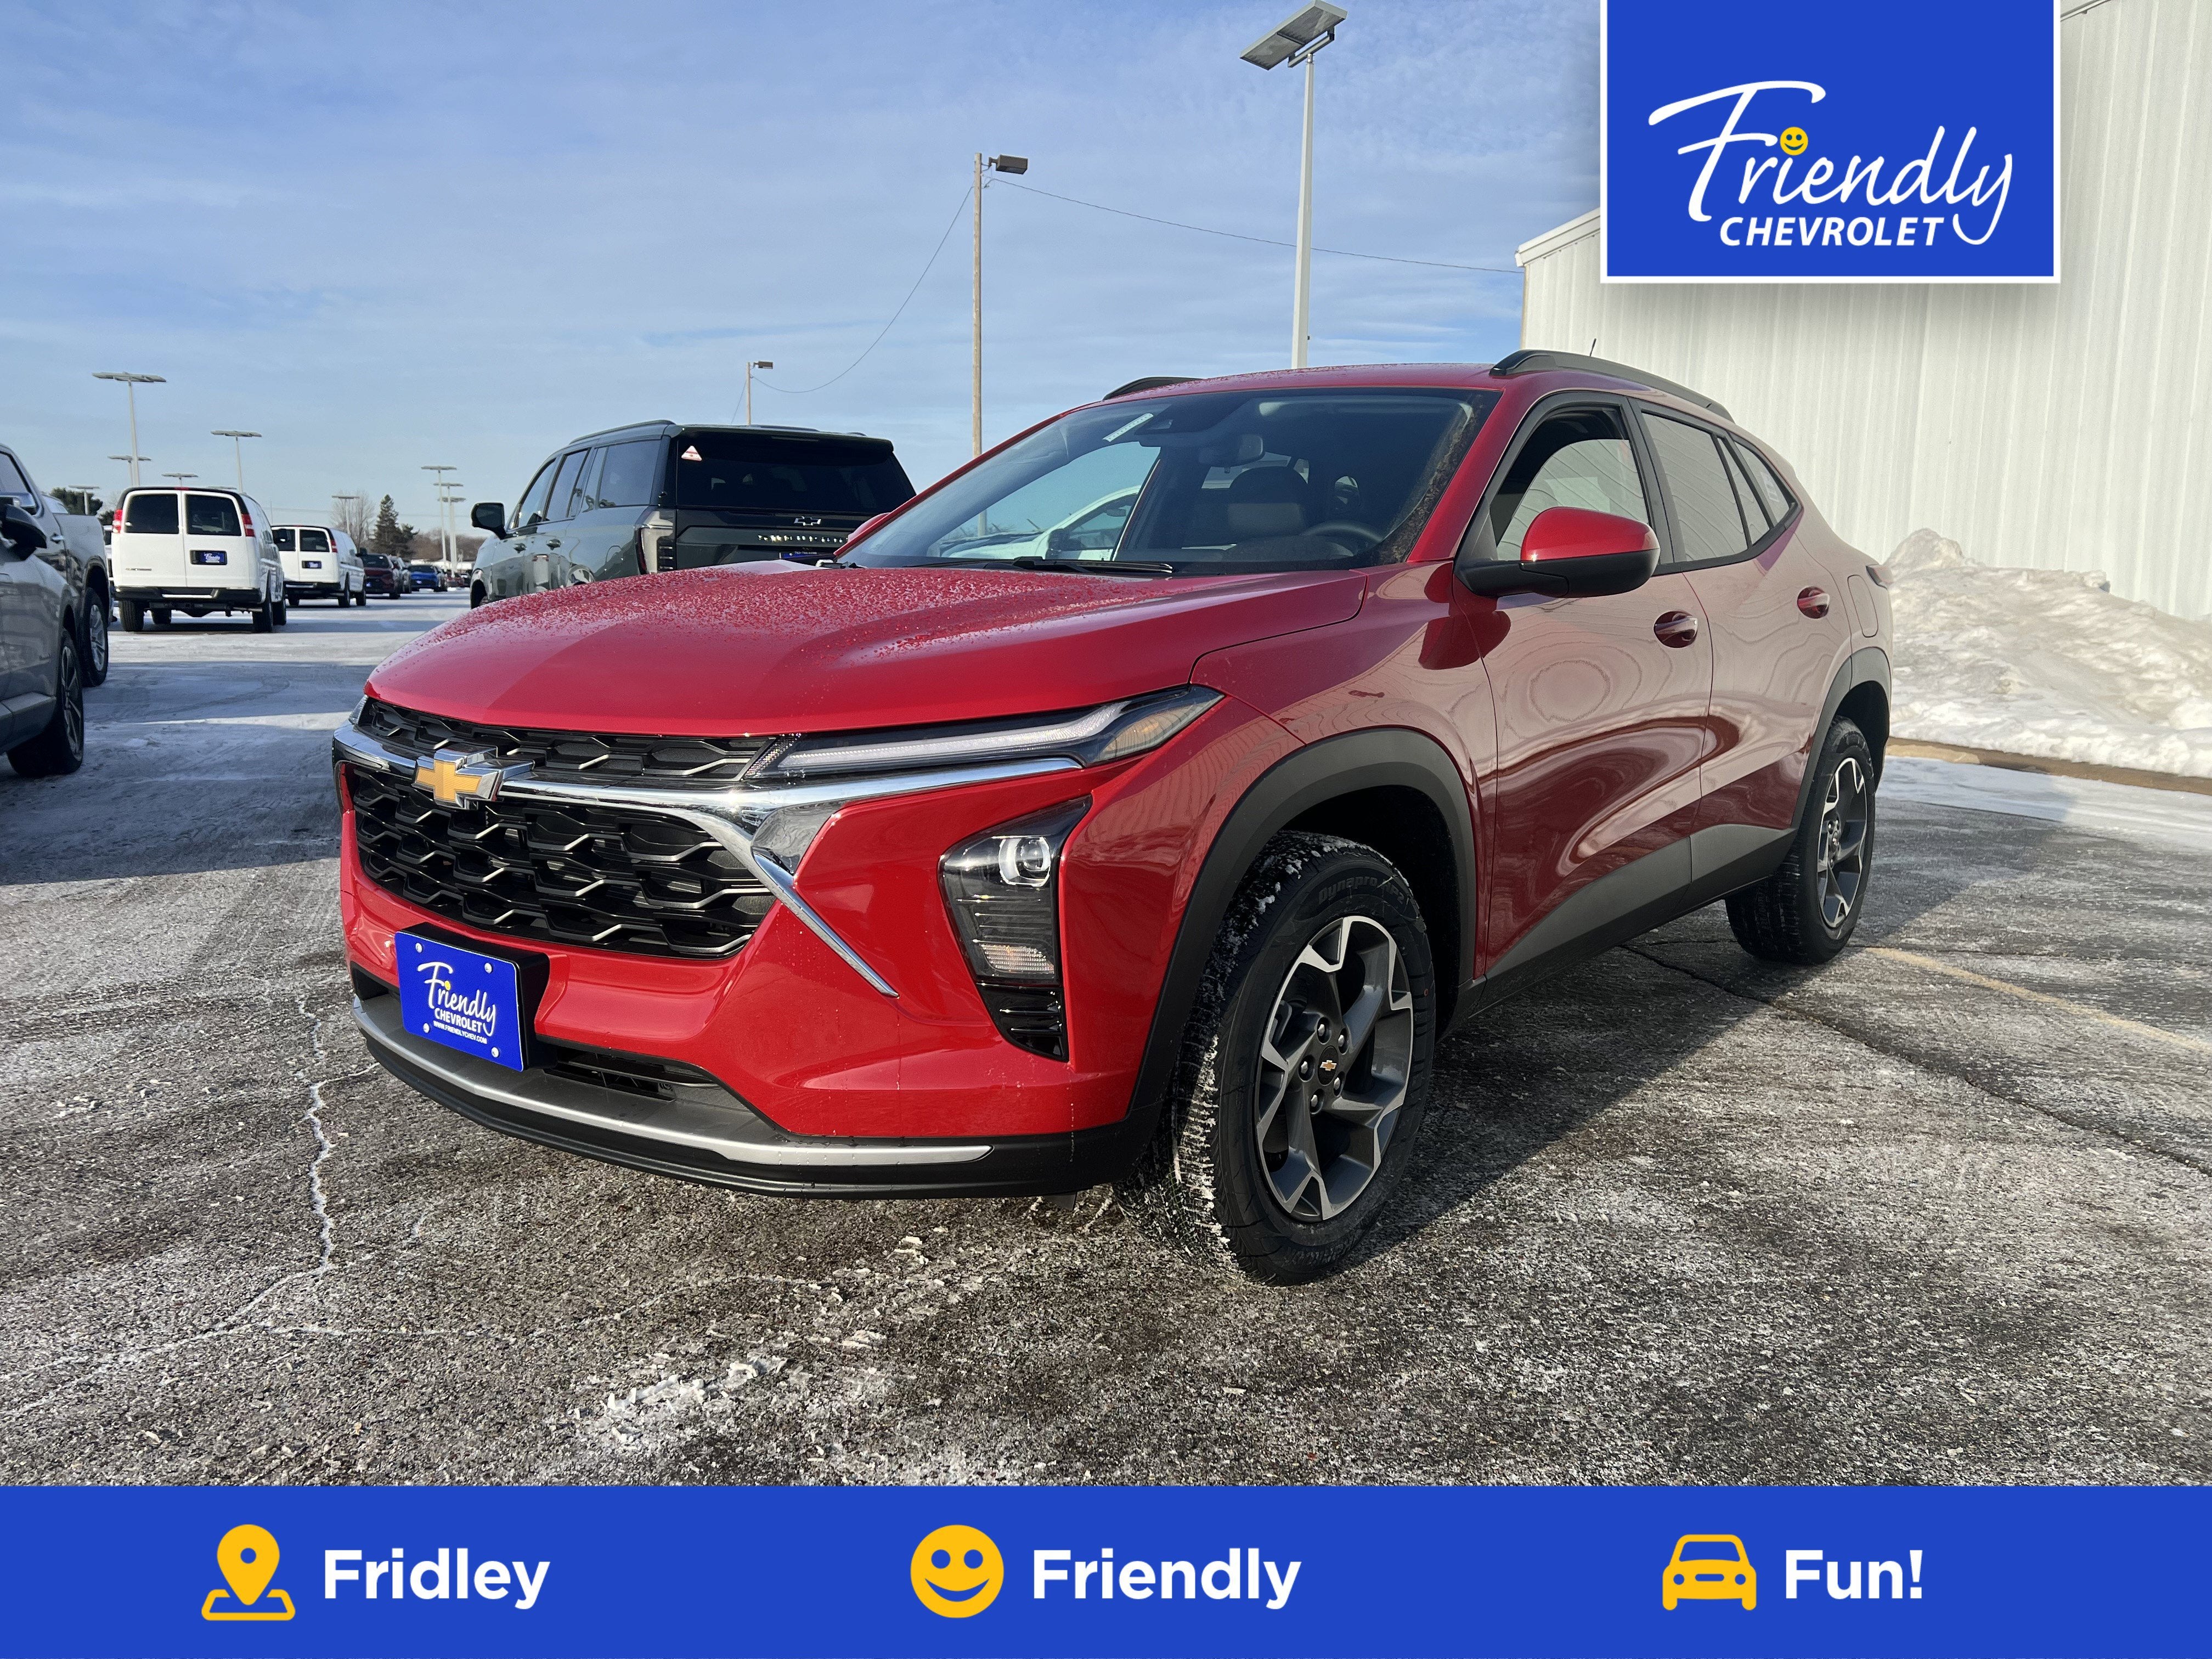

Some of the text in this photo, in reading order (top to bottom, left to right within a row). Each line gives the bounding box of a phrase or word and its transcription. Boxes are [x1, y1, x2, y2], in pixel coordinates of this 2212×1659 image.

[1319, 876, 1378, 904] Dynapro
[417, 962, 496, 1036] Friendly
[435, 1008, 483, 1034] CHEVROLET
